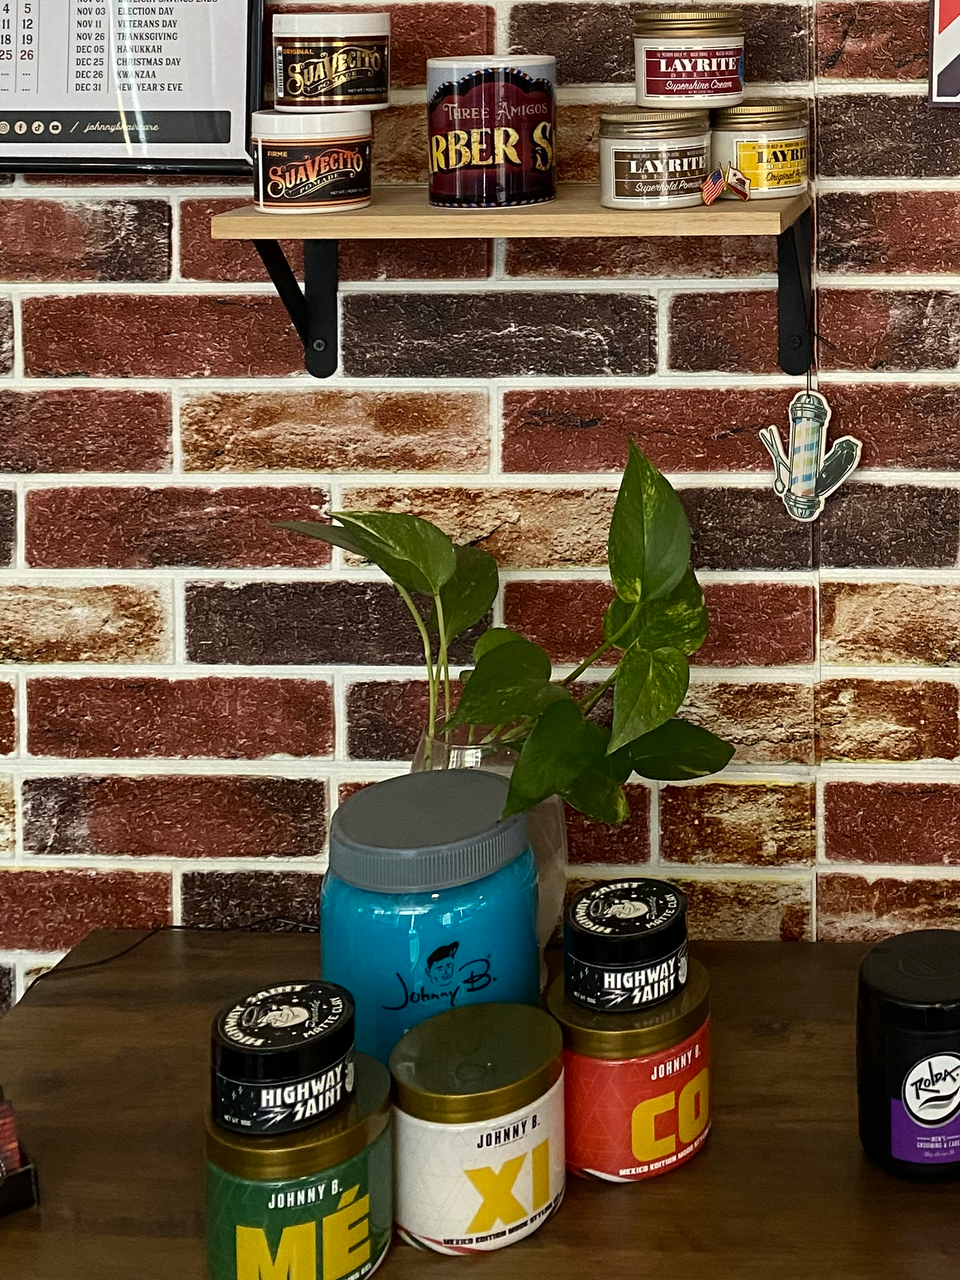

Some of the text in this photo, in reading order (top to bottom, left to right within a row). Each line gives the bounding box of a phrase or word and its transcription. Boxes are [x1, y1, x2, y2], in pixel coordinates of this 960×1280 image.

[287, 47, 381, 95] SUAVECITO
[659, 58, 736, 72] LAYRITE
[665, 80, 732, 91] Supershine Cream
[267, 148, 363, 198] SUAVECITO
[630, 156, 705, 173] LAYRITE
[635, 182, 677, 192] Superhold
[382, 958, 497, 1010] Johnny B.
[604, 956, 676, 988] HIGHWAY
[631, 972, 676, 1005] SAINT
[651, 1050, 692, 1080] JOHNNY
[261, 1063, 344, 1107] HIGHWAY
[292, 1082, 342, 1122] SAINT
[631, 1067, 709, 1162] CO
[477, 1115, 540, 1148] JOHNNY B.
[268, 1179, 342, 1209] JOHNNY B.
[463, 1138, 549, 1235] XI
[236, 1184, 370, 1280] MÉ
